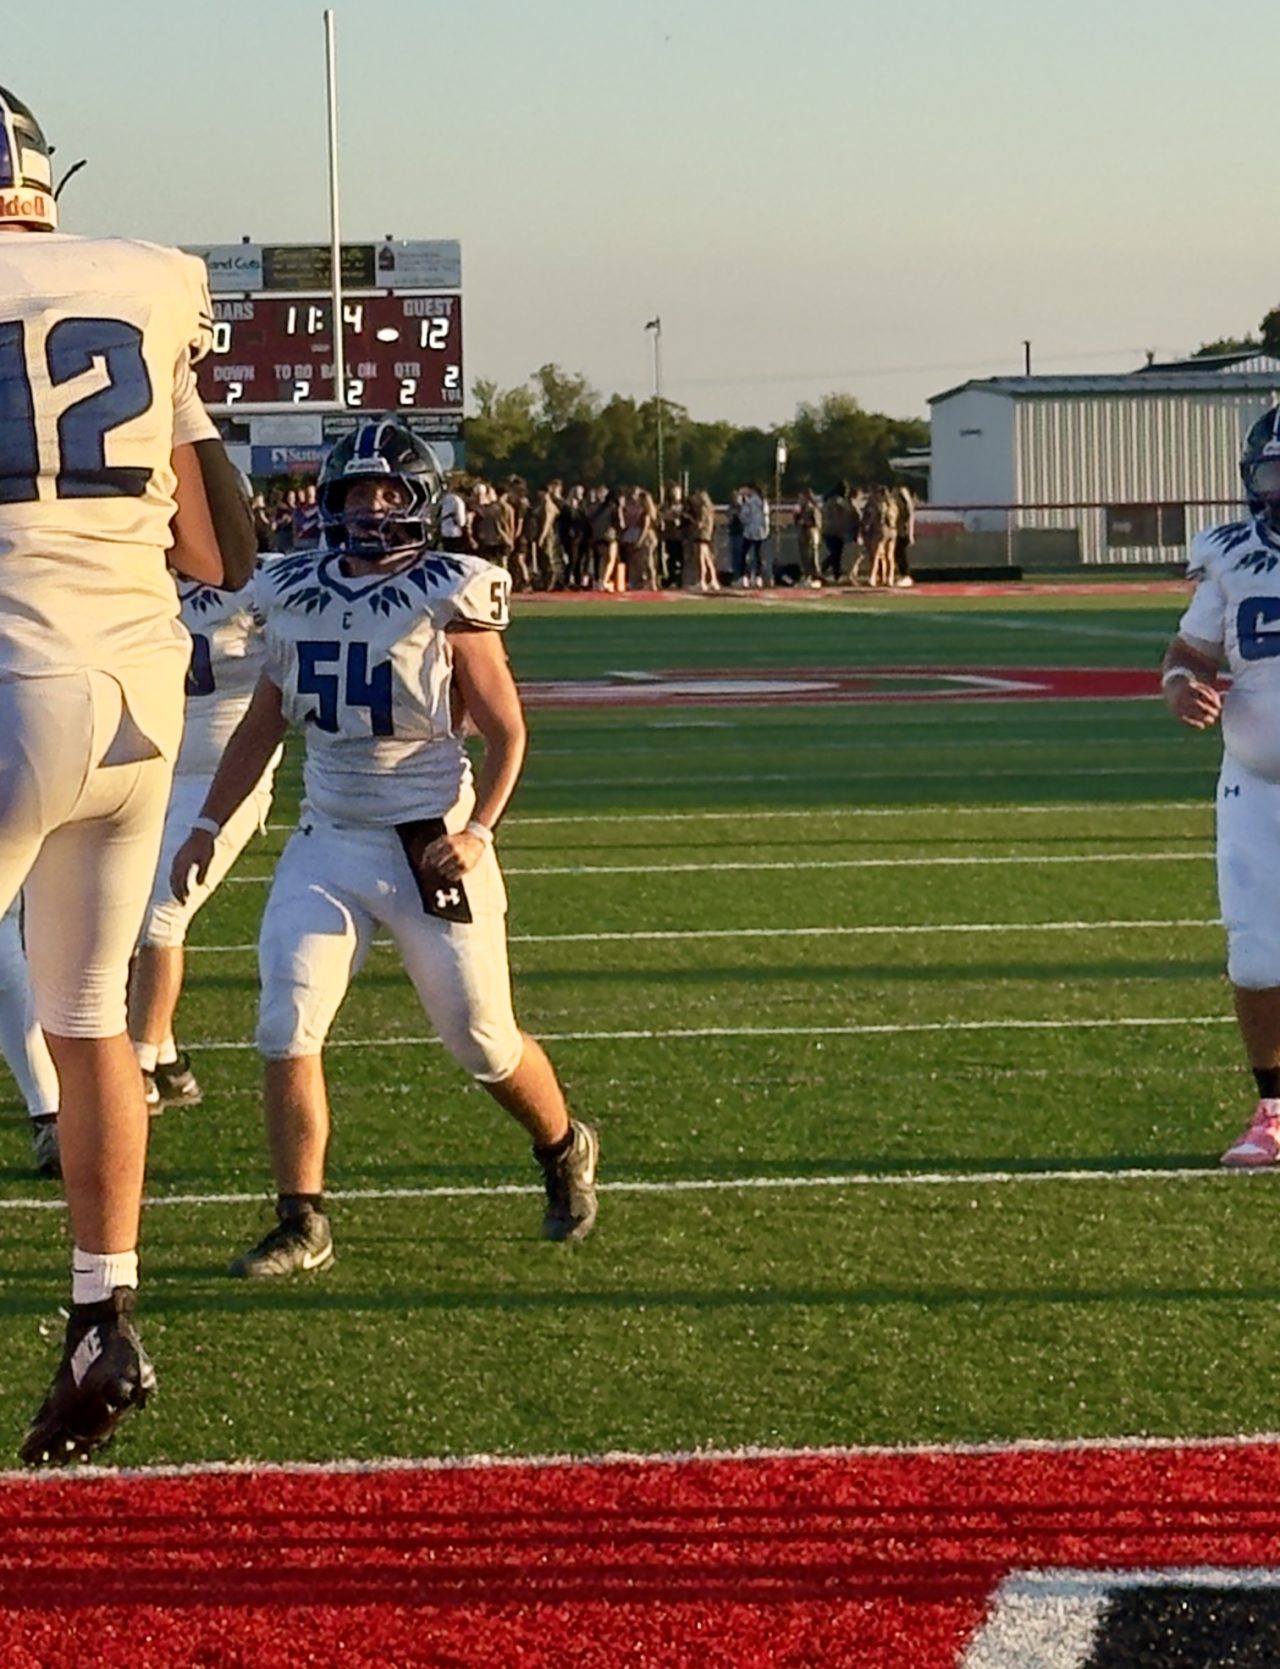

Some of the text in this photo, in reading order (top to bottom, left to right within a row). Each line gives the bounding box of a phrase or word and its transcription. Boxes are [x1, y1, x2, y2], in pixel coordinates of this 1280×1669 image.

[402, 297, 454, 317] GUEST
[212, 321, 232, 354] 0
[421, 317, 450, 350] 12
[213, 364, 255, 382] DOWN
[273, 363, 313, 380] TO GO
[394, 361, 421, 379] QTR
[443, 365, 460, 389] 2
[347, 379, 364, 406] 2
[400, 378, 417, 405] 2
[296, 640, 395, 738] 54
